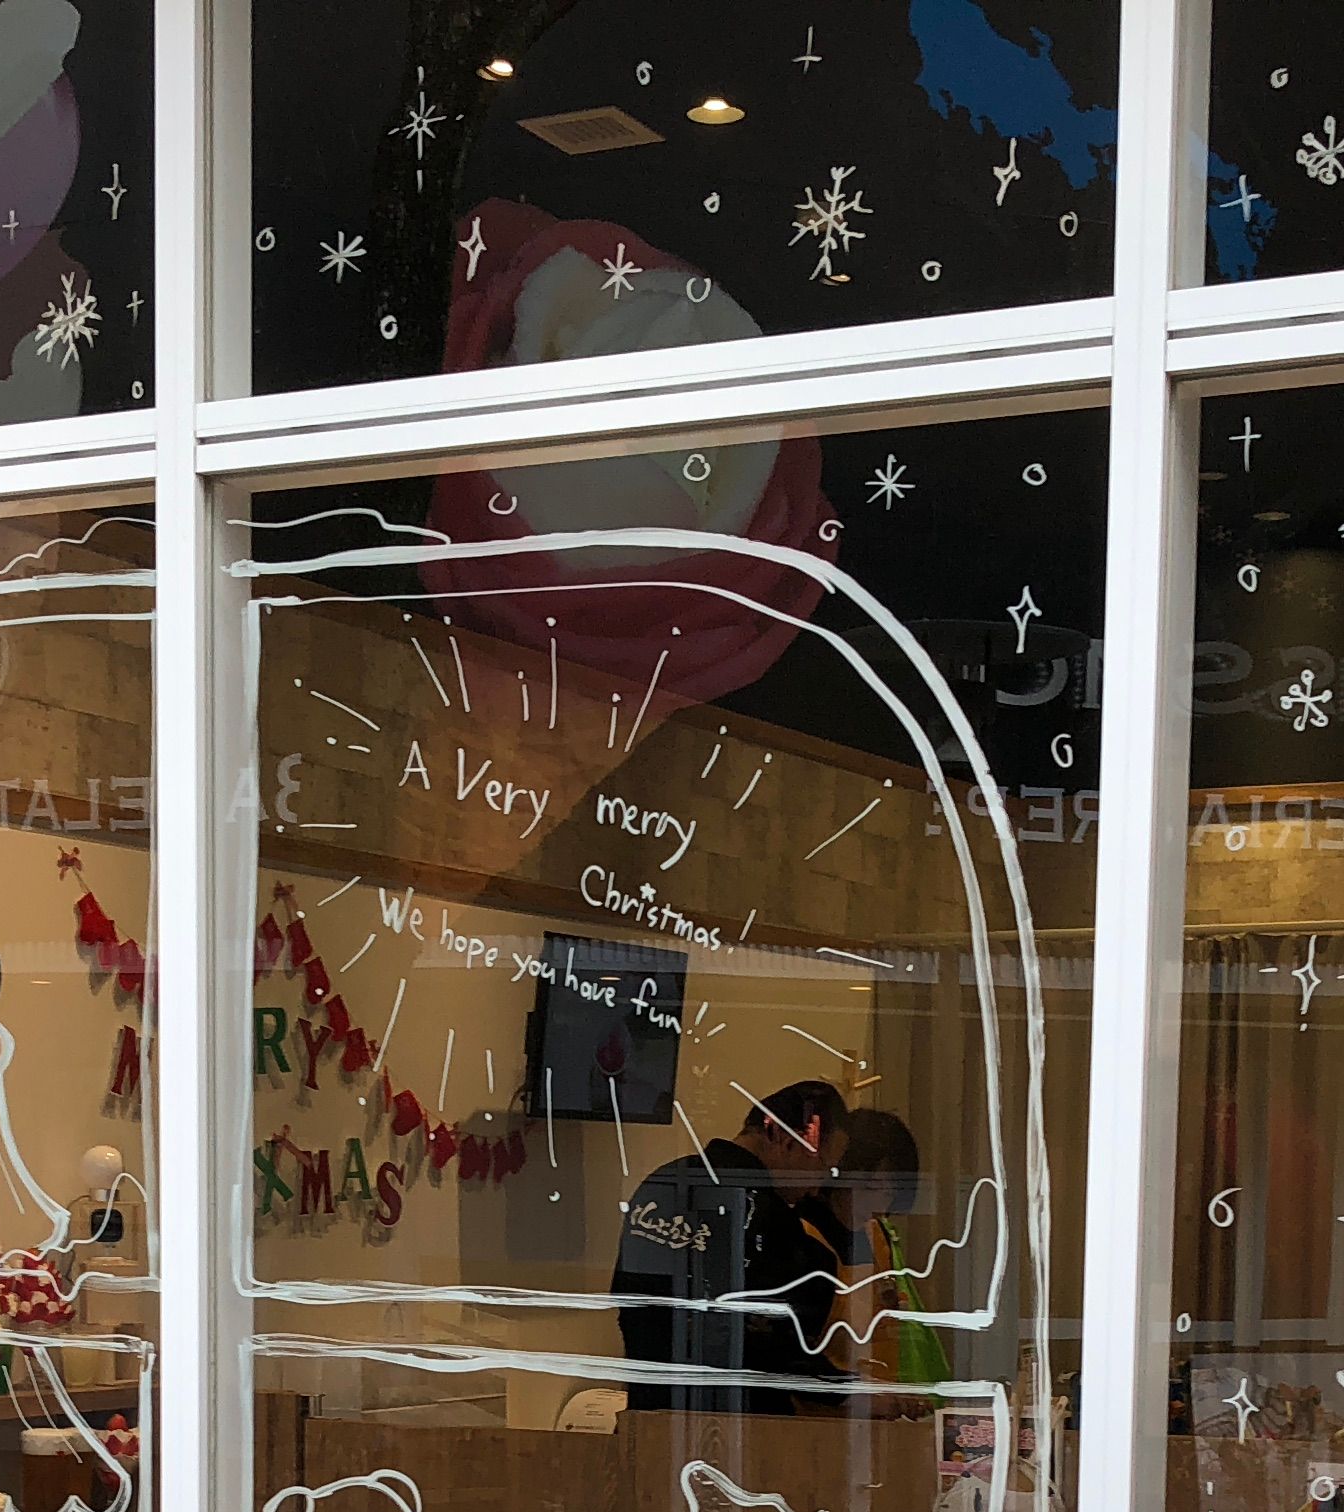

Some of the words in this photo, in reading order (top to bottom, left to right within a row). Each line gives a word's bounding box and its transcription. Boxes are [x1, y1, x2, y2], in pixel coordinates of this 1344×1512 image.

[398, 741, 431, 790] A
[457, 748, 550, 839] Very
[596, 794, 697, 871] merry
[379, 887, 425, 941] We
[440, 909, 498, 969] hope
[511, 952, 556, 986] you
[564, 947, 617, 1008] have
[252, 1137, 406, 1227] XMAS
